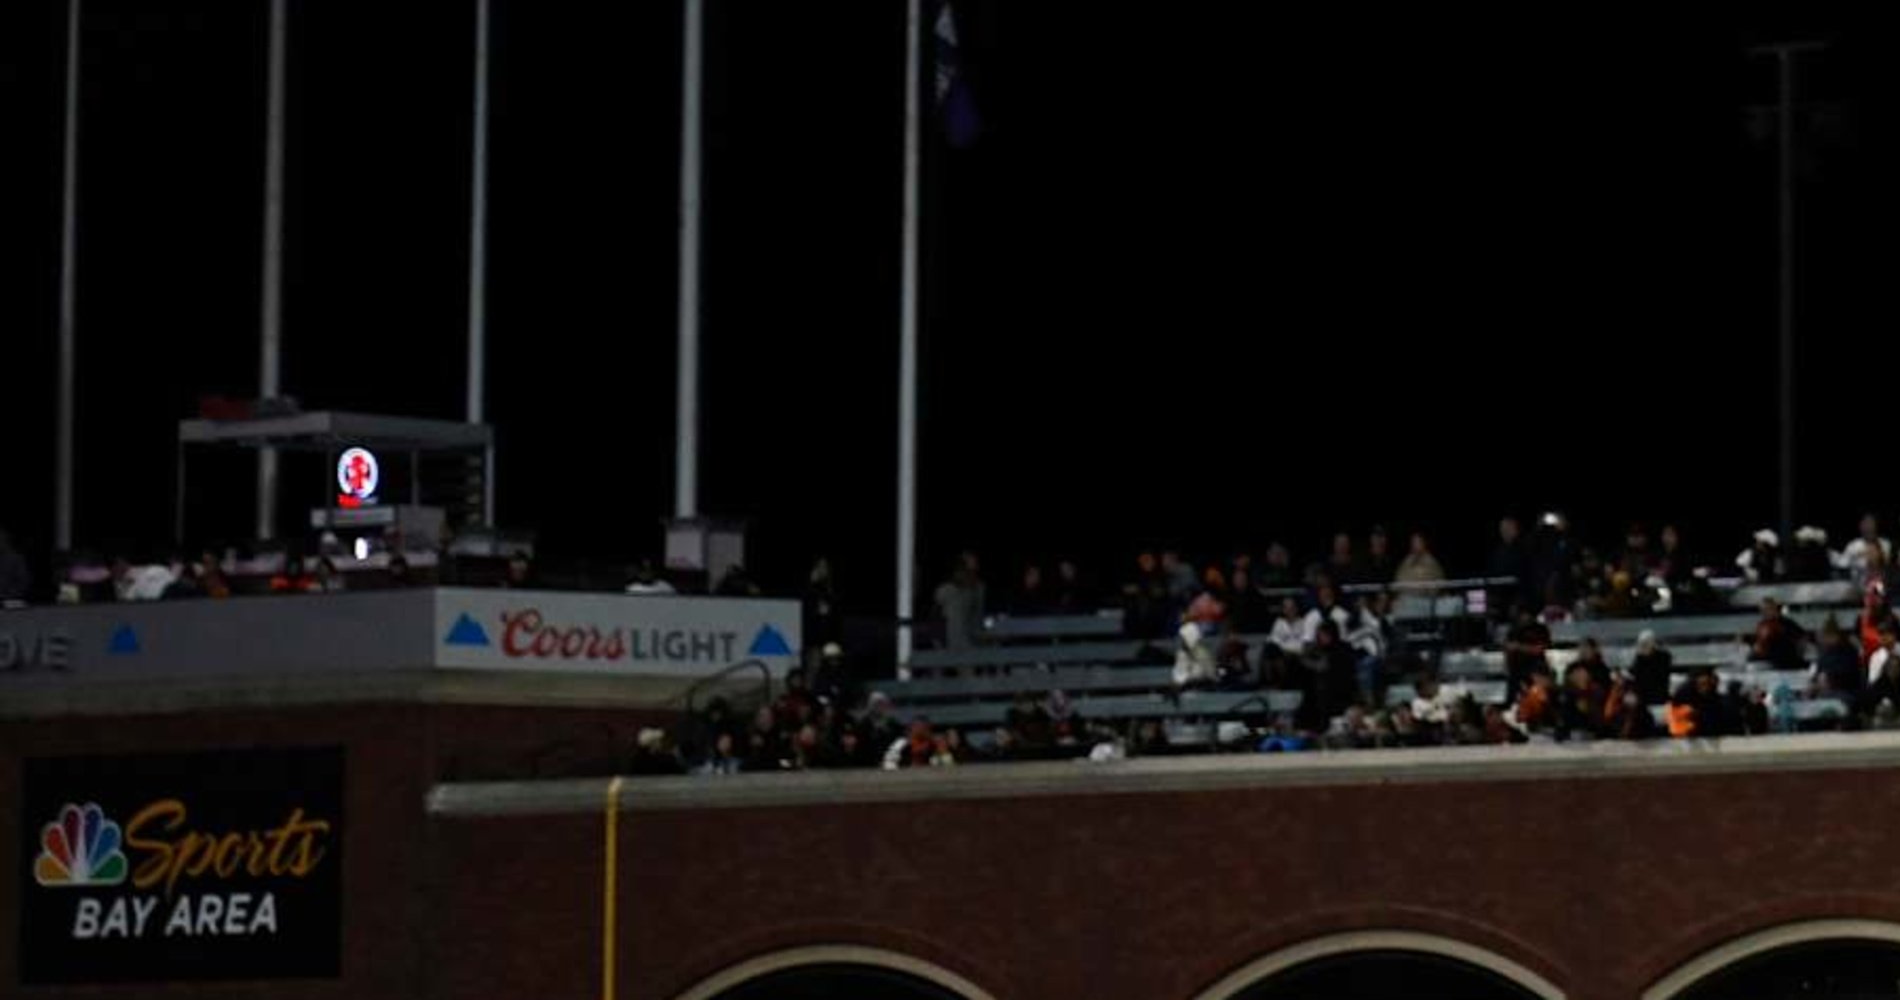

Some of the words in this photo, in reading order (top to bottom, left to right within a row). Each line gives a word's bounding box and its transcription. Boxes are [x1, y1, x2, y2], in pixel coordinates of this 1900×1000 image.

[500, 608, 626, 661] Coors
[631, 629, 738, 663] LIGHT
[125, 798, 332, 898] Sports
[70, 896, 160, 940] BAY
[163, 891, 280, 937] AREA
